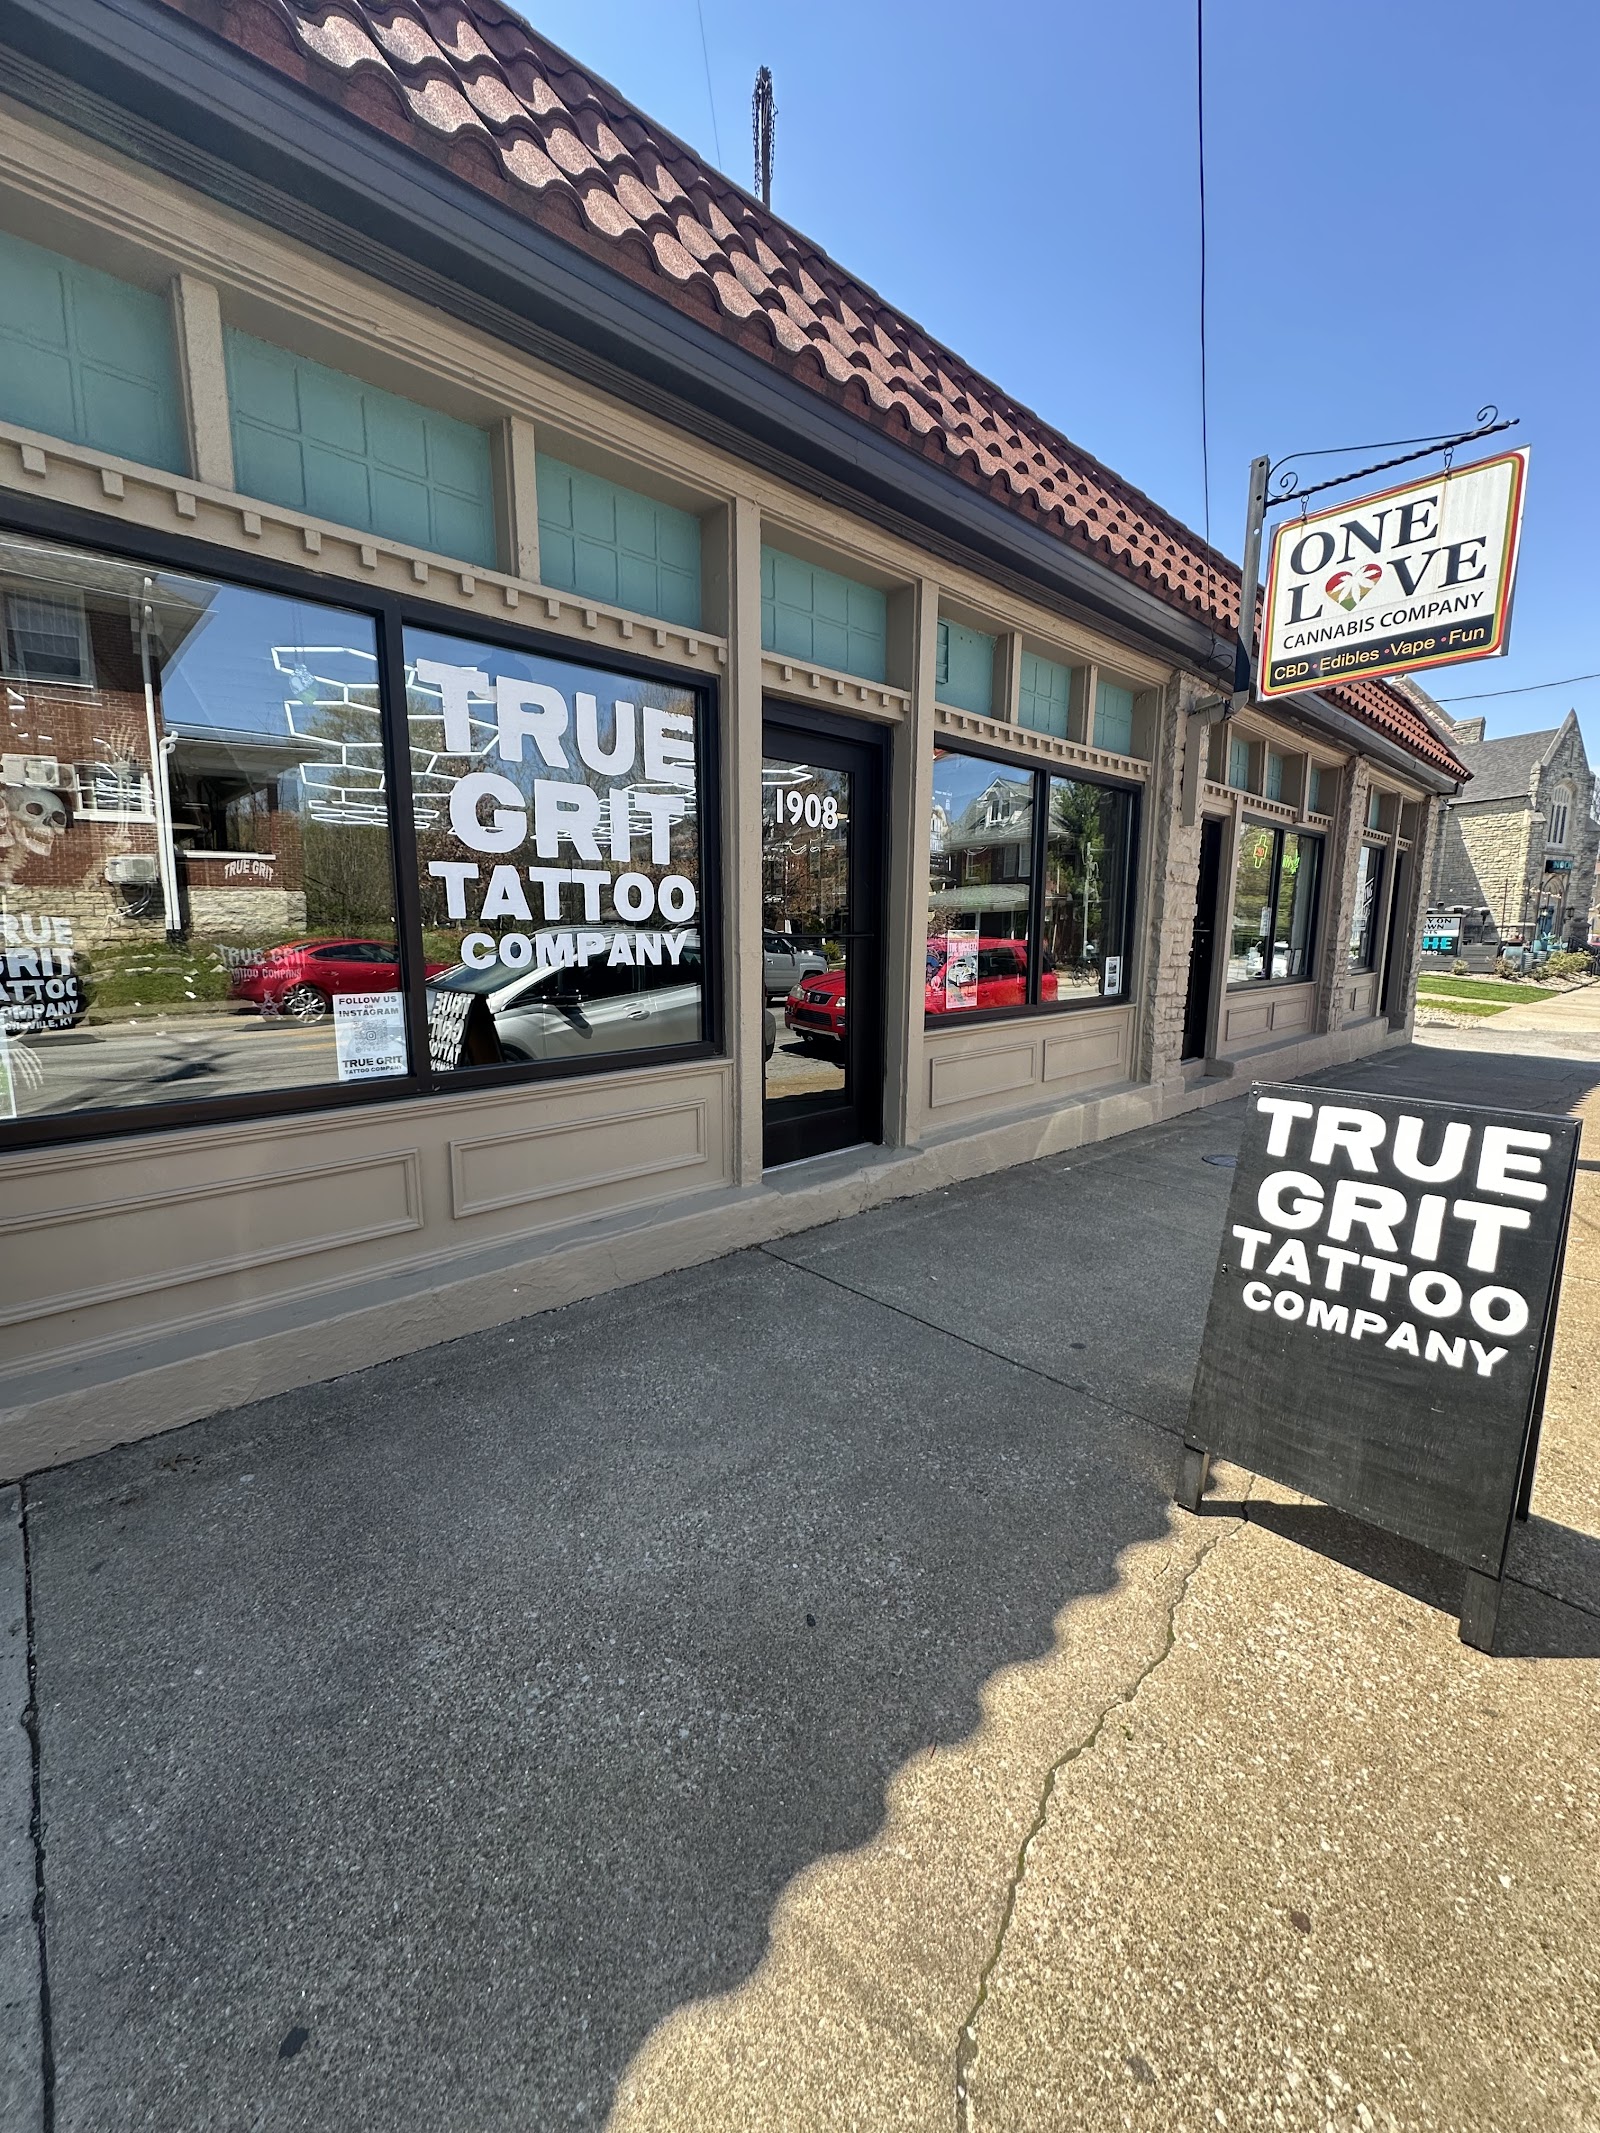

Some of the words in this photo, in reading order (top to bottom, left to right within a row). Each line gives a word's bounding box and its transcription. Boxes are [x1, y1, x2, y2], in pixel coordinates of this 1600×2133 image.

[1290, 495, 1438, 576] ONE
[1283, 616, 1375, 650] CANNABIS
[1379, 591, 1484, 628] COMPANY
[1274, 661, 1309, 681] CBD
[1319, 648, 1380, 672] Edibles
[1389, 635, 1436, 657] Vape
[1448, 626, 1485, 645] Fun
[416, 658, 696, 786] TRUE
[449, 772, 685, 865] GRIT
[776, 788, 839, 830] 1908
[224, 859, 250, 880] TRUE
[252, 860, 274, 882] GRIT
[428, 861, 696, 922] TATTOO
[0, 914, 73, 945] RUE
[1422, 937, 1453, 950] HE
[0, 947, 74, 978] RIT
[213, 943, 267, 970] TRUE
[270, 943, 311, 969] GRIT
[460, 932, 687, 969] COMPANY
[262, 967, 302, 980] COMPANY
[1, 1000, 79, 1020] OMPANY
[338, 996, 380, 1005] FOLLOW
[383, 995, 398, 1003] US
[338, 1007, 399, 1018] INSTAGRAM
[342, 1057, 374, 1068] TRUE
[376, 1055, 403, 1065] GRIT
[344, 1067, 370, 1075] TATTOO
[1256, 1096, 1552, 1201] TRUE
[1257, 1170, 1532, 1273] GRIT
[1232, 1224, 1529, 1336] TATTOO
[1242, 1281, 1509, 1377] COMPANY
